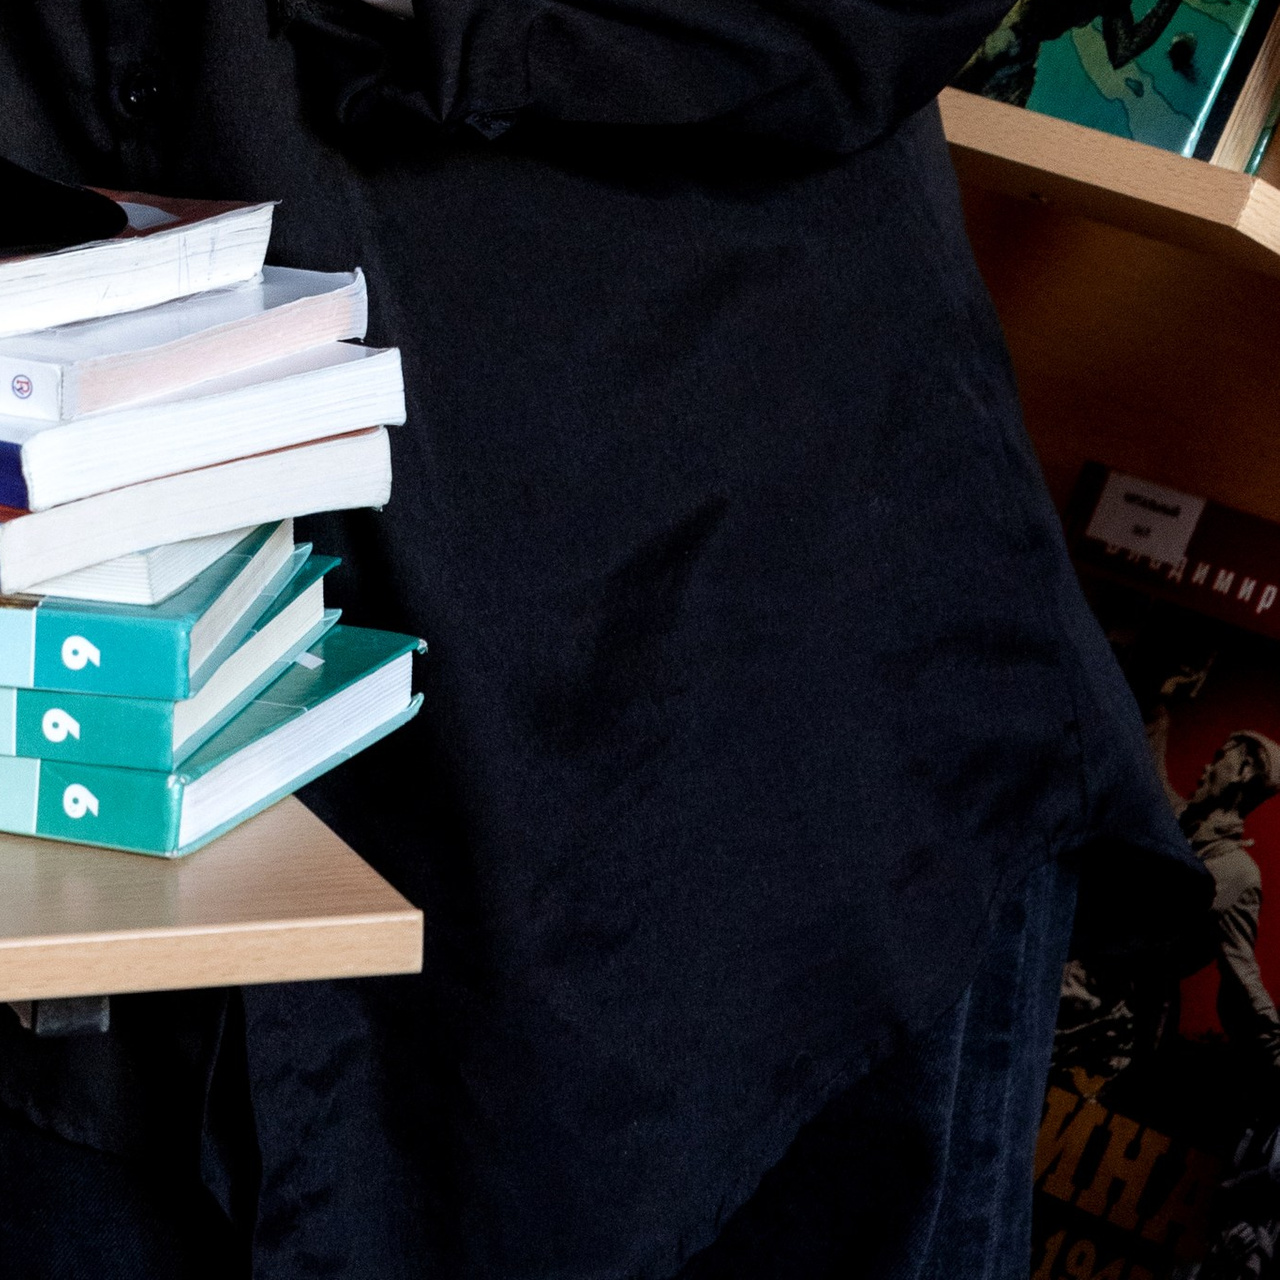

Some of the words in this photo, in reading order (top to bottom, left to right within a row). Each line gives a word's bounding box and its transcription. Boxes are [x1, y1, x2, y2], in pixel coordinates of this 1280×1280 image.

[61, 634, 101, 678] 9
[42, 707, 81, 744] 9
[63, 782, 100, 820] 9
